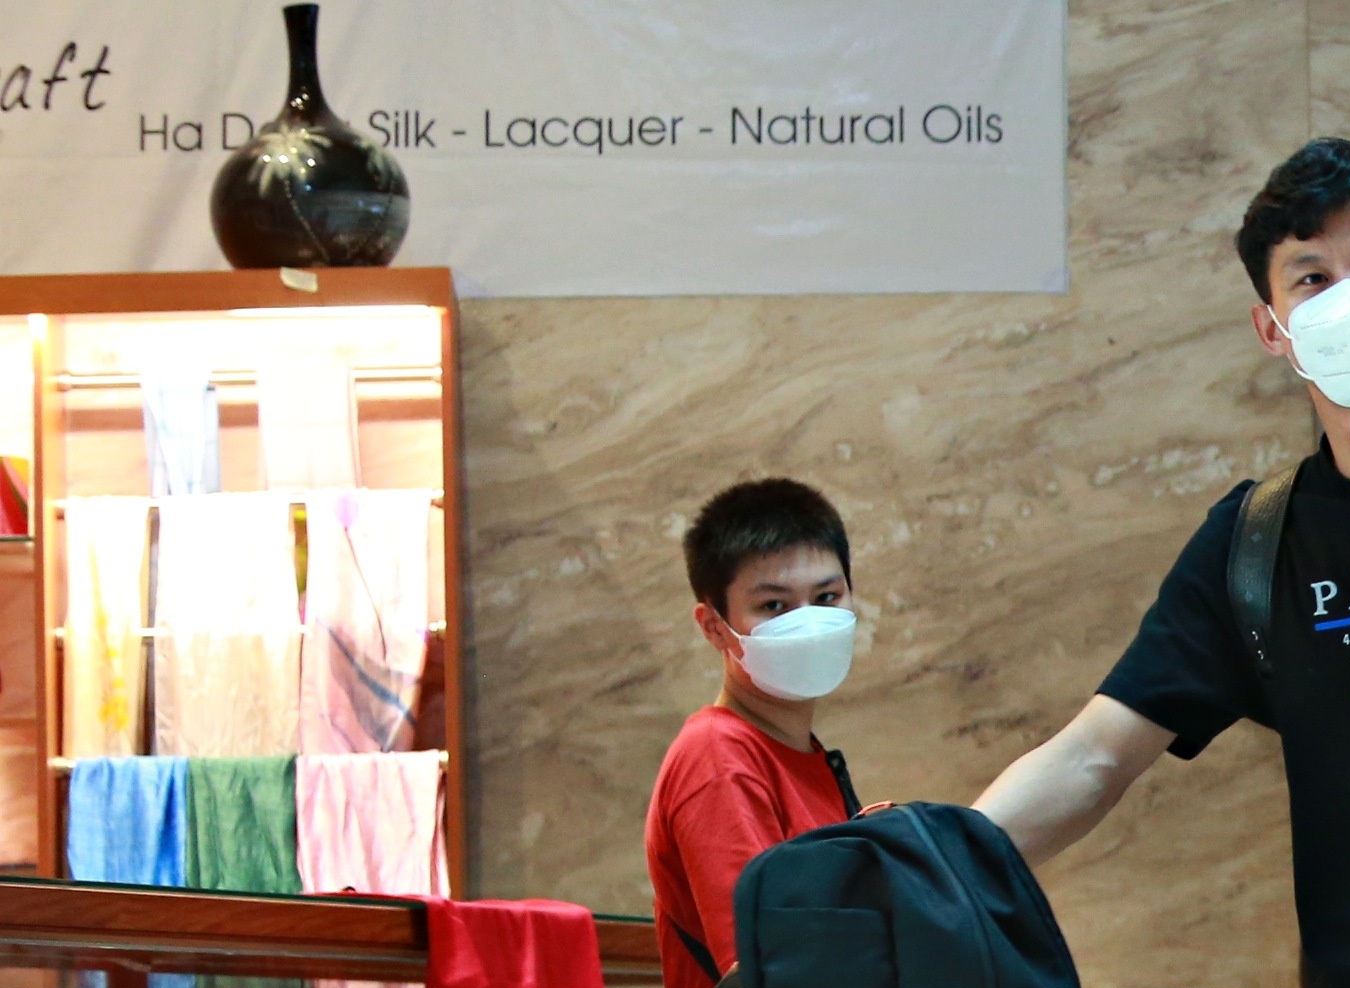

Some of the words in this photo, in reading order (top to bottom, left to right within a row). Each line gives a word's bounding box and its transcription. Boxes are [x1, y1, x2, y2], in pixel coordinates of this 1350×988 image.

[140, 114, 203, 152] Ha
[368, 110, 435, 148] Silk
[485, 109, 683, 155] Lacquer
[731, 105, 904, 145] Natural
[922, 104, 1003, 144] Oils
